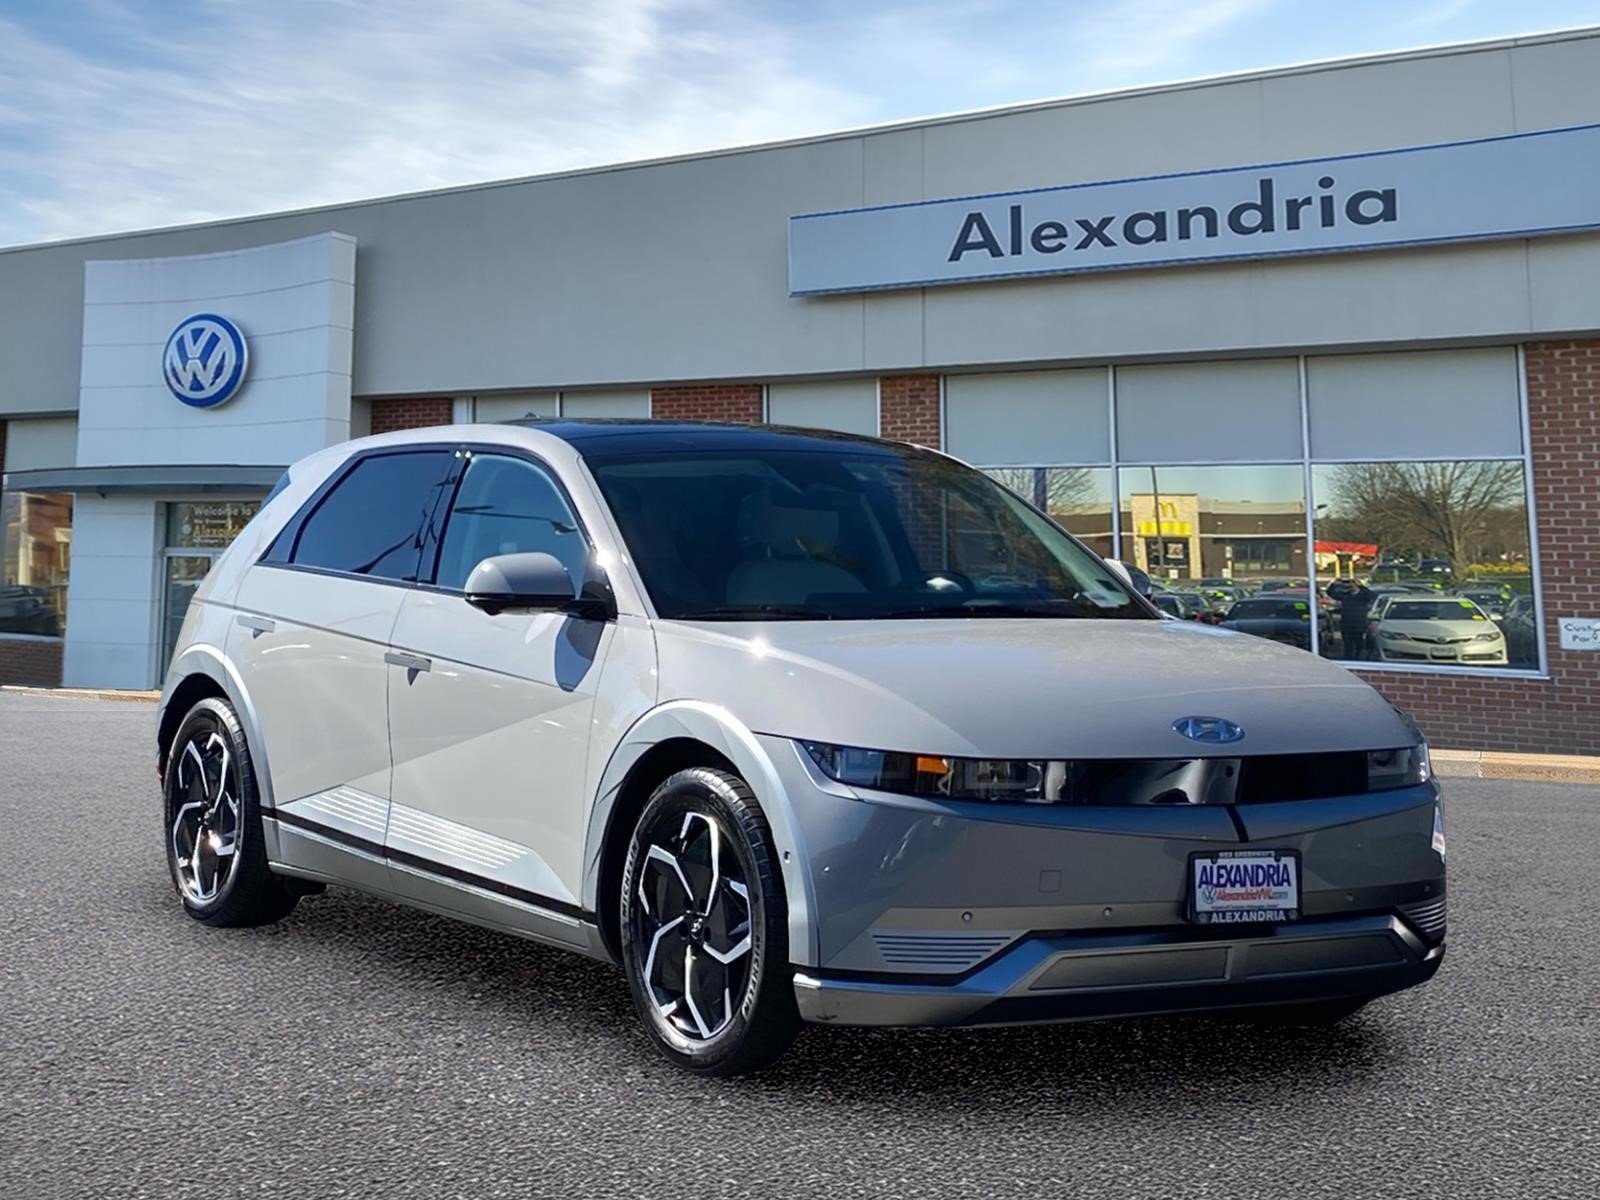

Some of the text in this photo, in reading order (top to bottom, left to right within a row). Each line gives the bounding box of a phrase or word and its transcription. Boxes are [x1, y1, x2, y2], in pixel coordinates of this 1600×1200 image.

[948, 176, 1398, 262] Alexandria
[621, 839, 640, 918] MICHELIN
[1198, 863, 1292, 889] ALEXANDRIA
[1211, 910, 1287, 923] ALEXANDRIA
[741, 934, 763, 1019] MICHELIN
